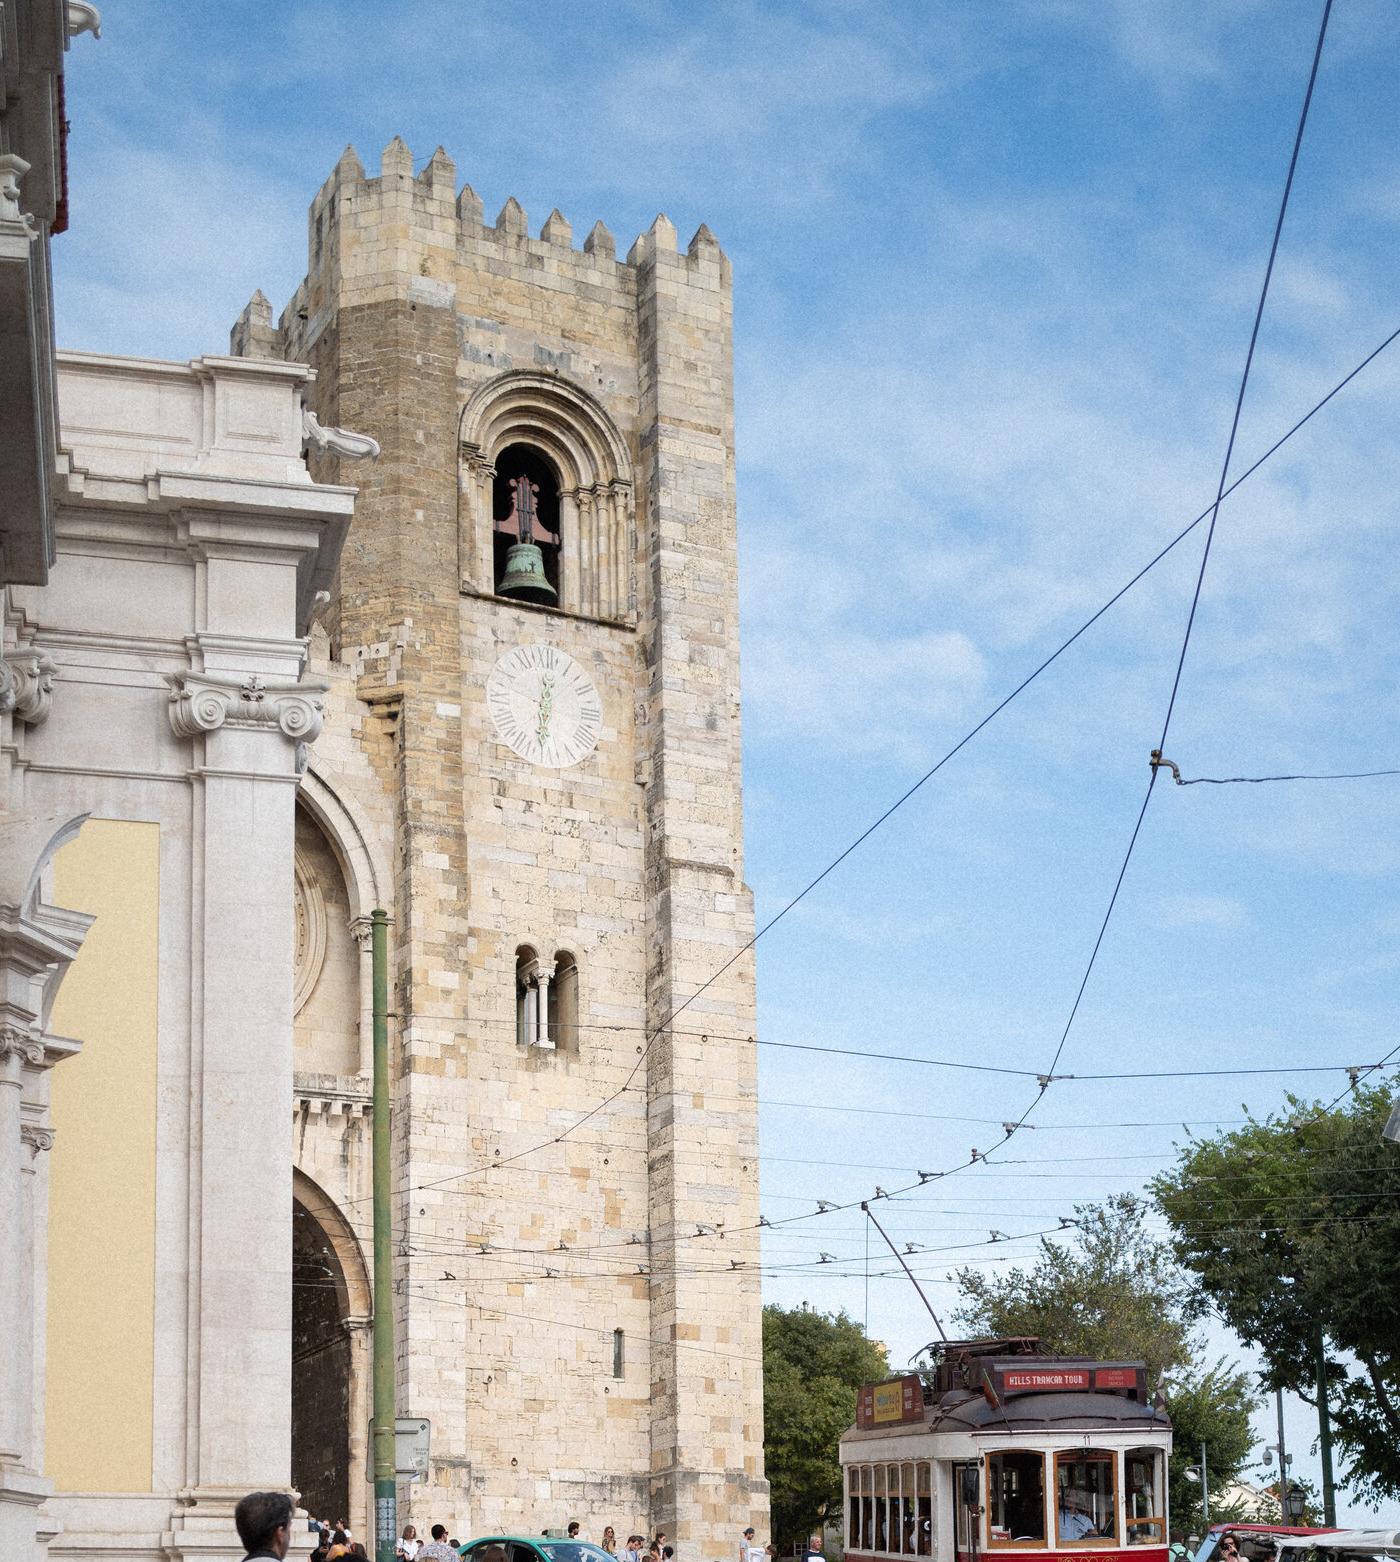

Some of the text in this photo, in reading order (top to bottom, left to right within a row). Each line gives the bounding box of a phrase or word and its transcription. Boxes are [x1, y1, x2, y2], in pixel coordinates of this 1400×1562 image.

[581, 708, 600, 722] III
[1009, 1376, 1031, 1385] HILLS
[1064, 1375, 1083, 1384] TOUR
[1083, 1435, 1091, 1446] 11
